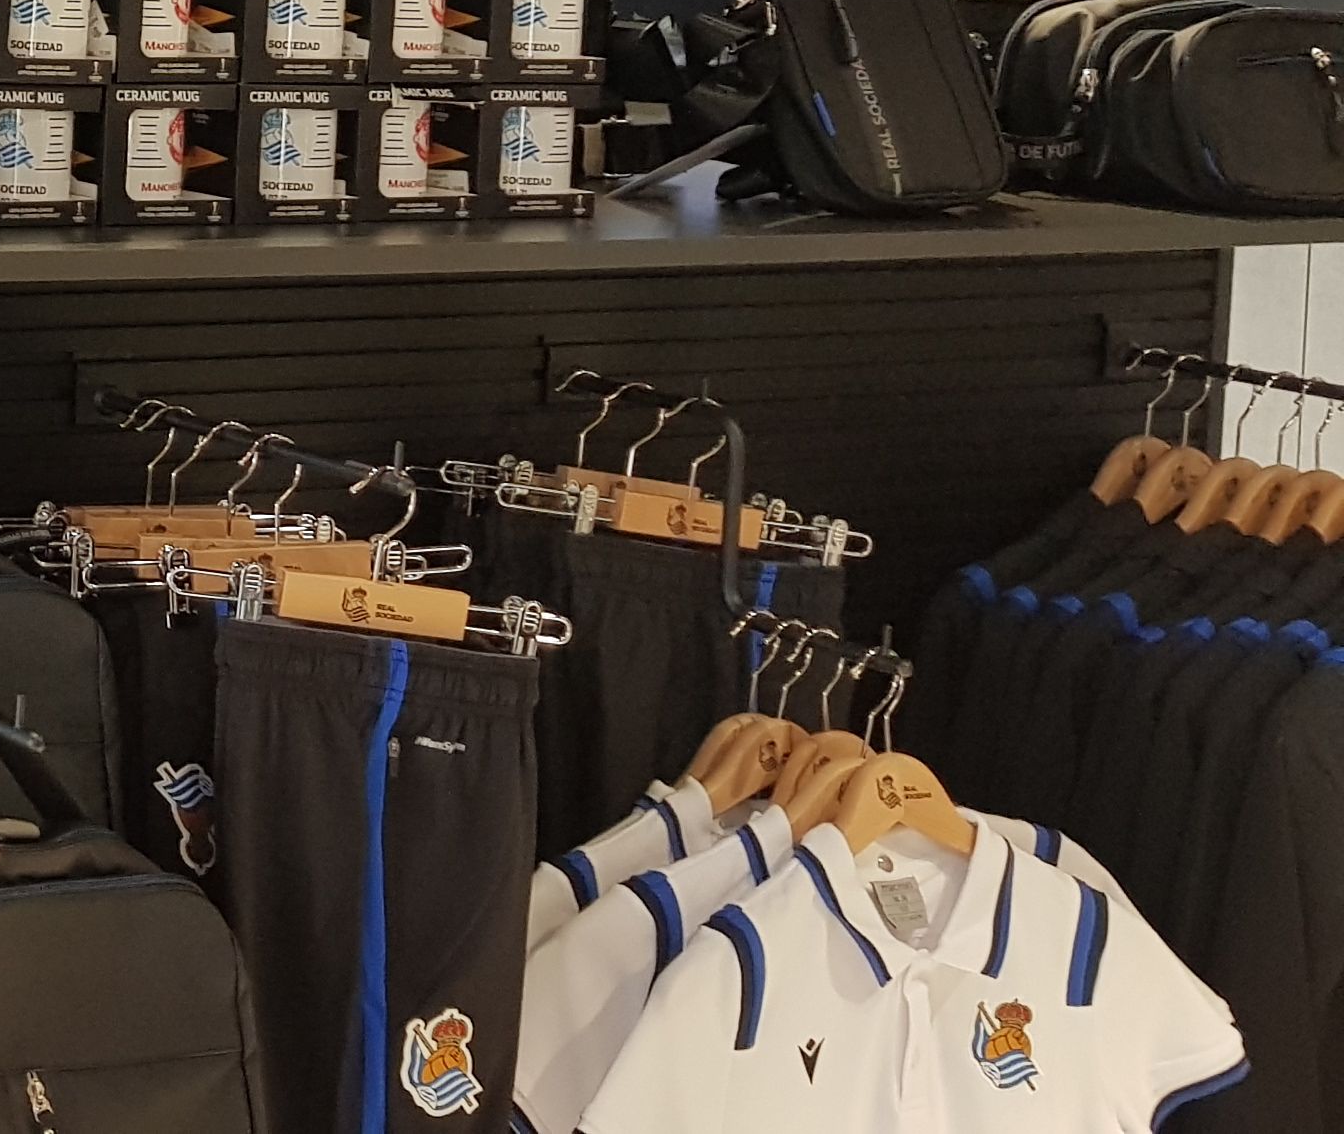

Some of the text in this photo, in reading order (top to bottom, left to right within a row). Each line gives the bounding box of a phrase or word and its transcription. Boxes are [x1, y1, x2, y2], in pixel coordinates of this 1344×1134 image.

[10, 39, 62, 52] SOCIEDAD
[268, 40, 320, 51] SOCIEDAD
[36, 91, 65, 105] MUG
[115, 89, 200, 103] CERAMIC MUG
[249, 91, 330, 104] CERAMIC MUG
[490, 89, 568, 102] CERAMIC MUG
[850, 58, 901, 170] REAL SOCIEDA
[262, 181, 313, 191] SOCIEDAD
[502, 176, 552, 186] SOCIEDAD
[376, 603, 396, 613] REAL
[375, 611, 414, 623] SOCIEDAD
